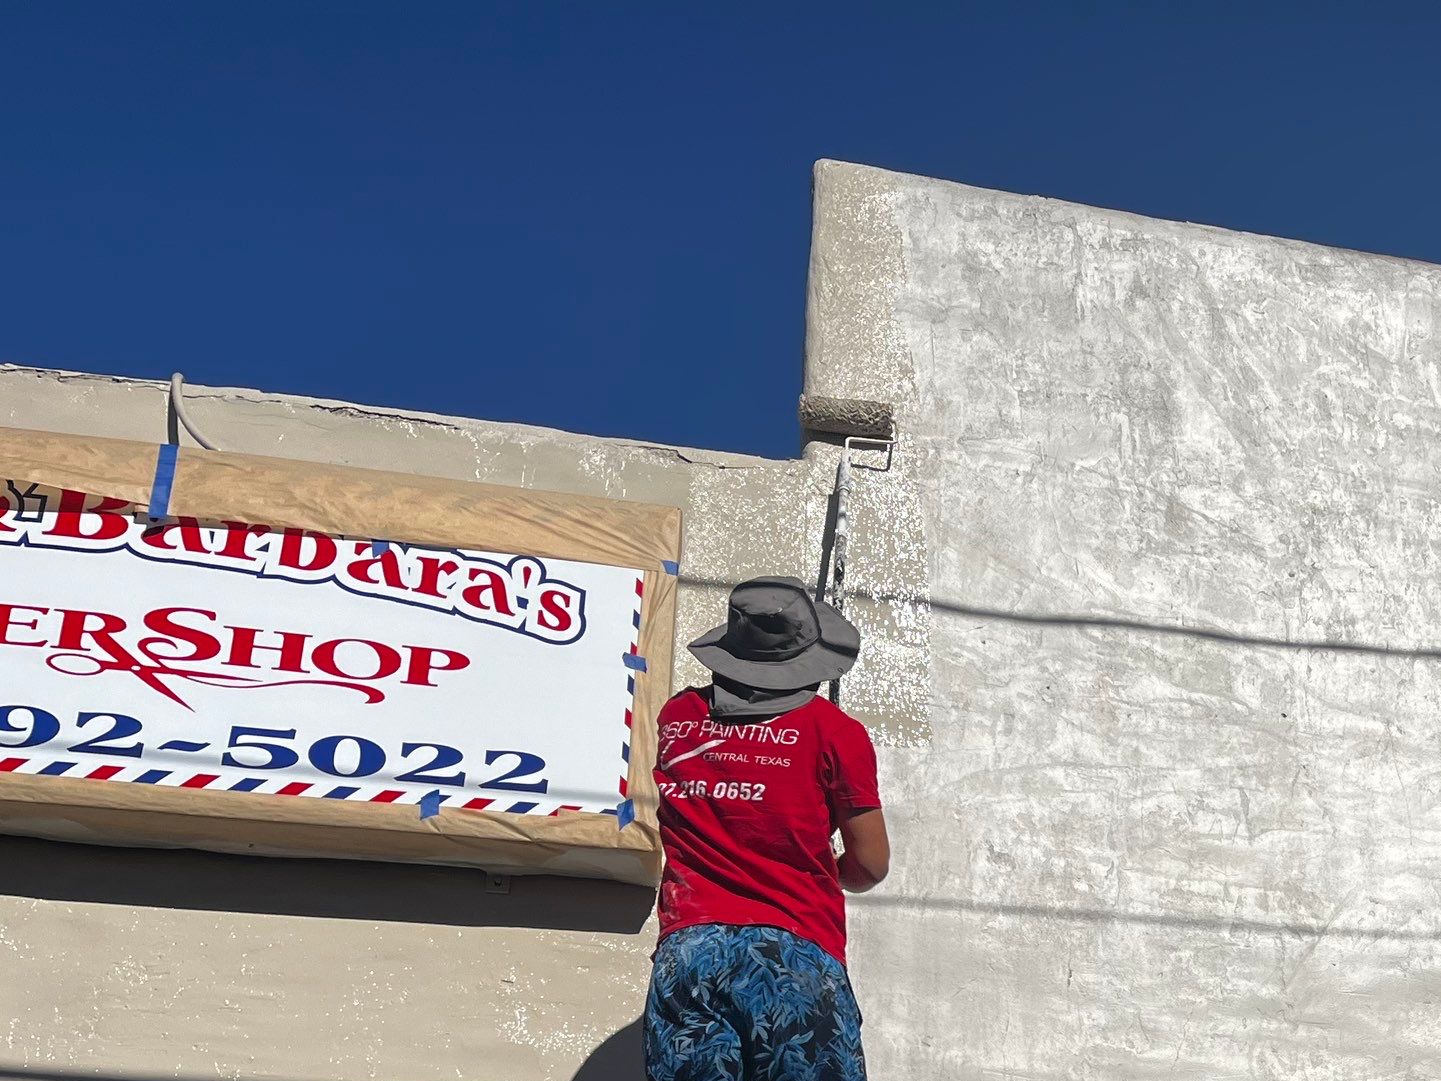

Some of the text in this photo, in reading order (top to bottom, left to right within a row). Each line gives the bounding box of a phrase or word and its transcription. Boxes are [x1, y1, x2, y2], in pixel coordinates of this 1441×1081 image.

[43, 489, 577, 632] Barbara's
[699, 720, 800, 745] PAINTING
[703, 752, 792, 767] CENTRAL TEXAS
